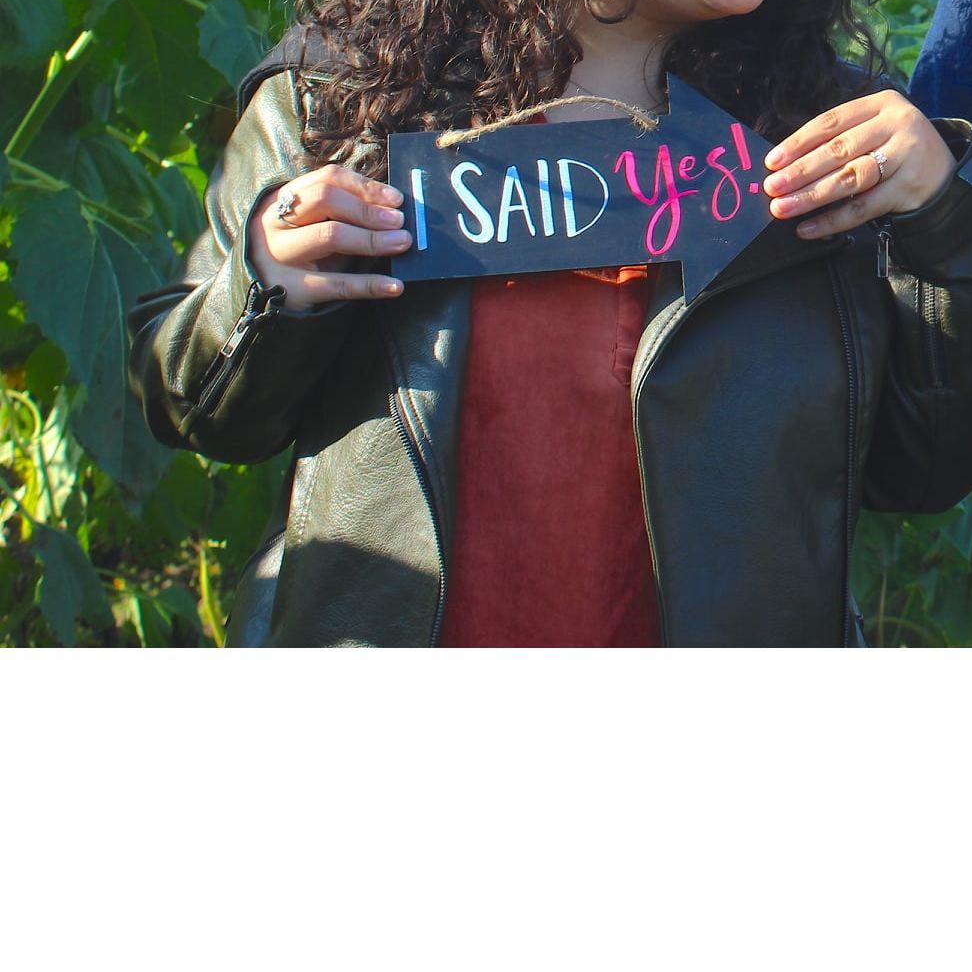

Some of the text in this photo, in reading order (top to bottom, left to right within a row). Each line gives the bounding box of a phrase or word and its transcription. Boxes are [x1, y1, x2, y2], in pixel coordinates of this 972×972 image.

[410, 122, 760, 256] I SAID Yes!
